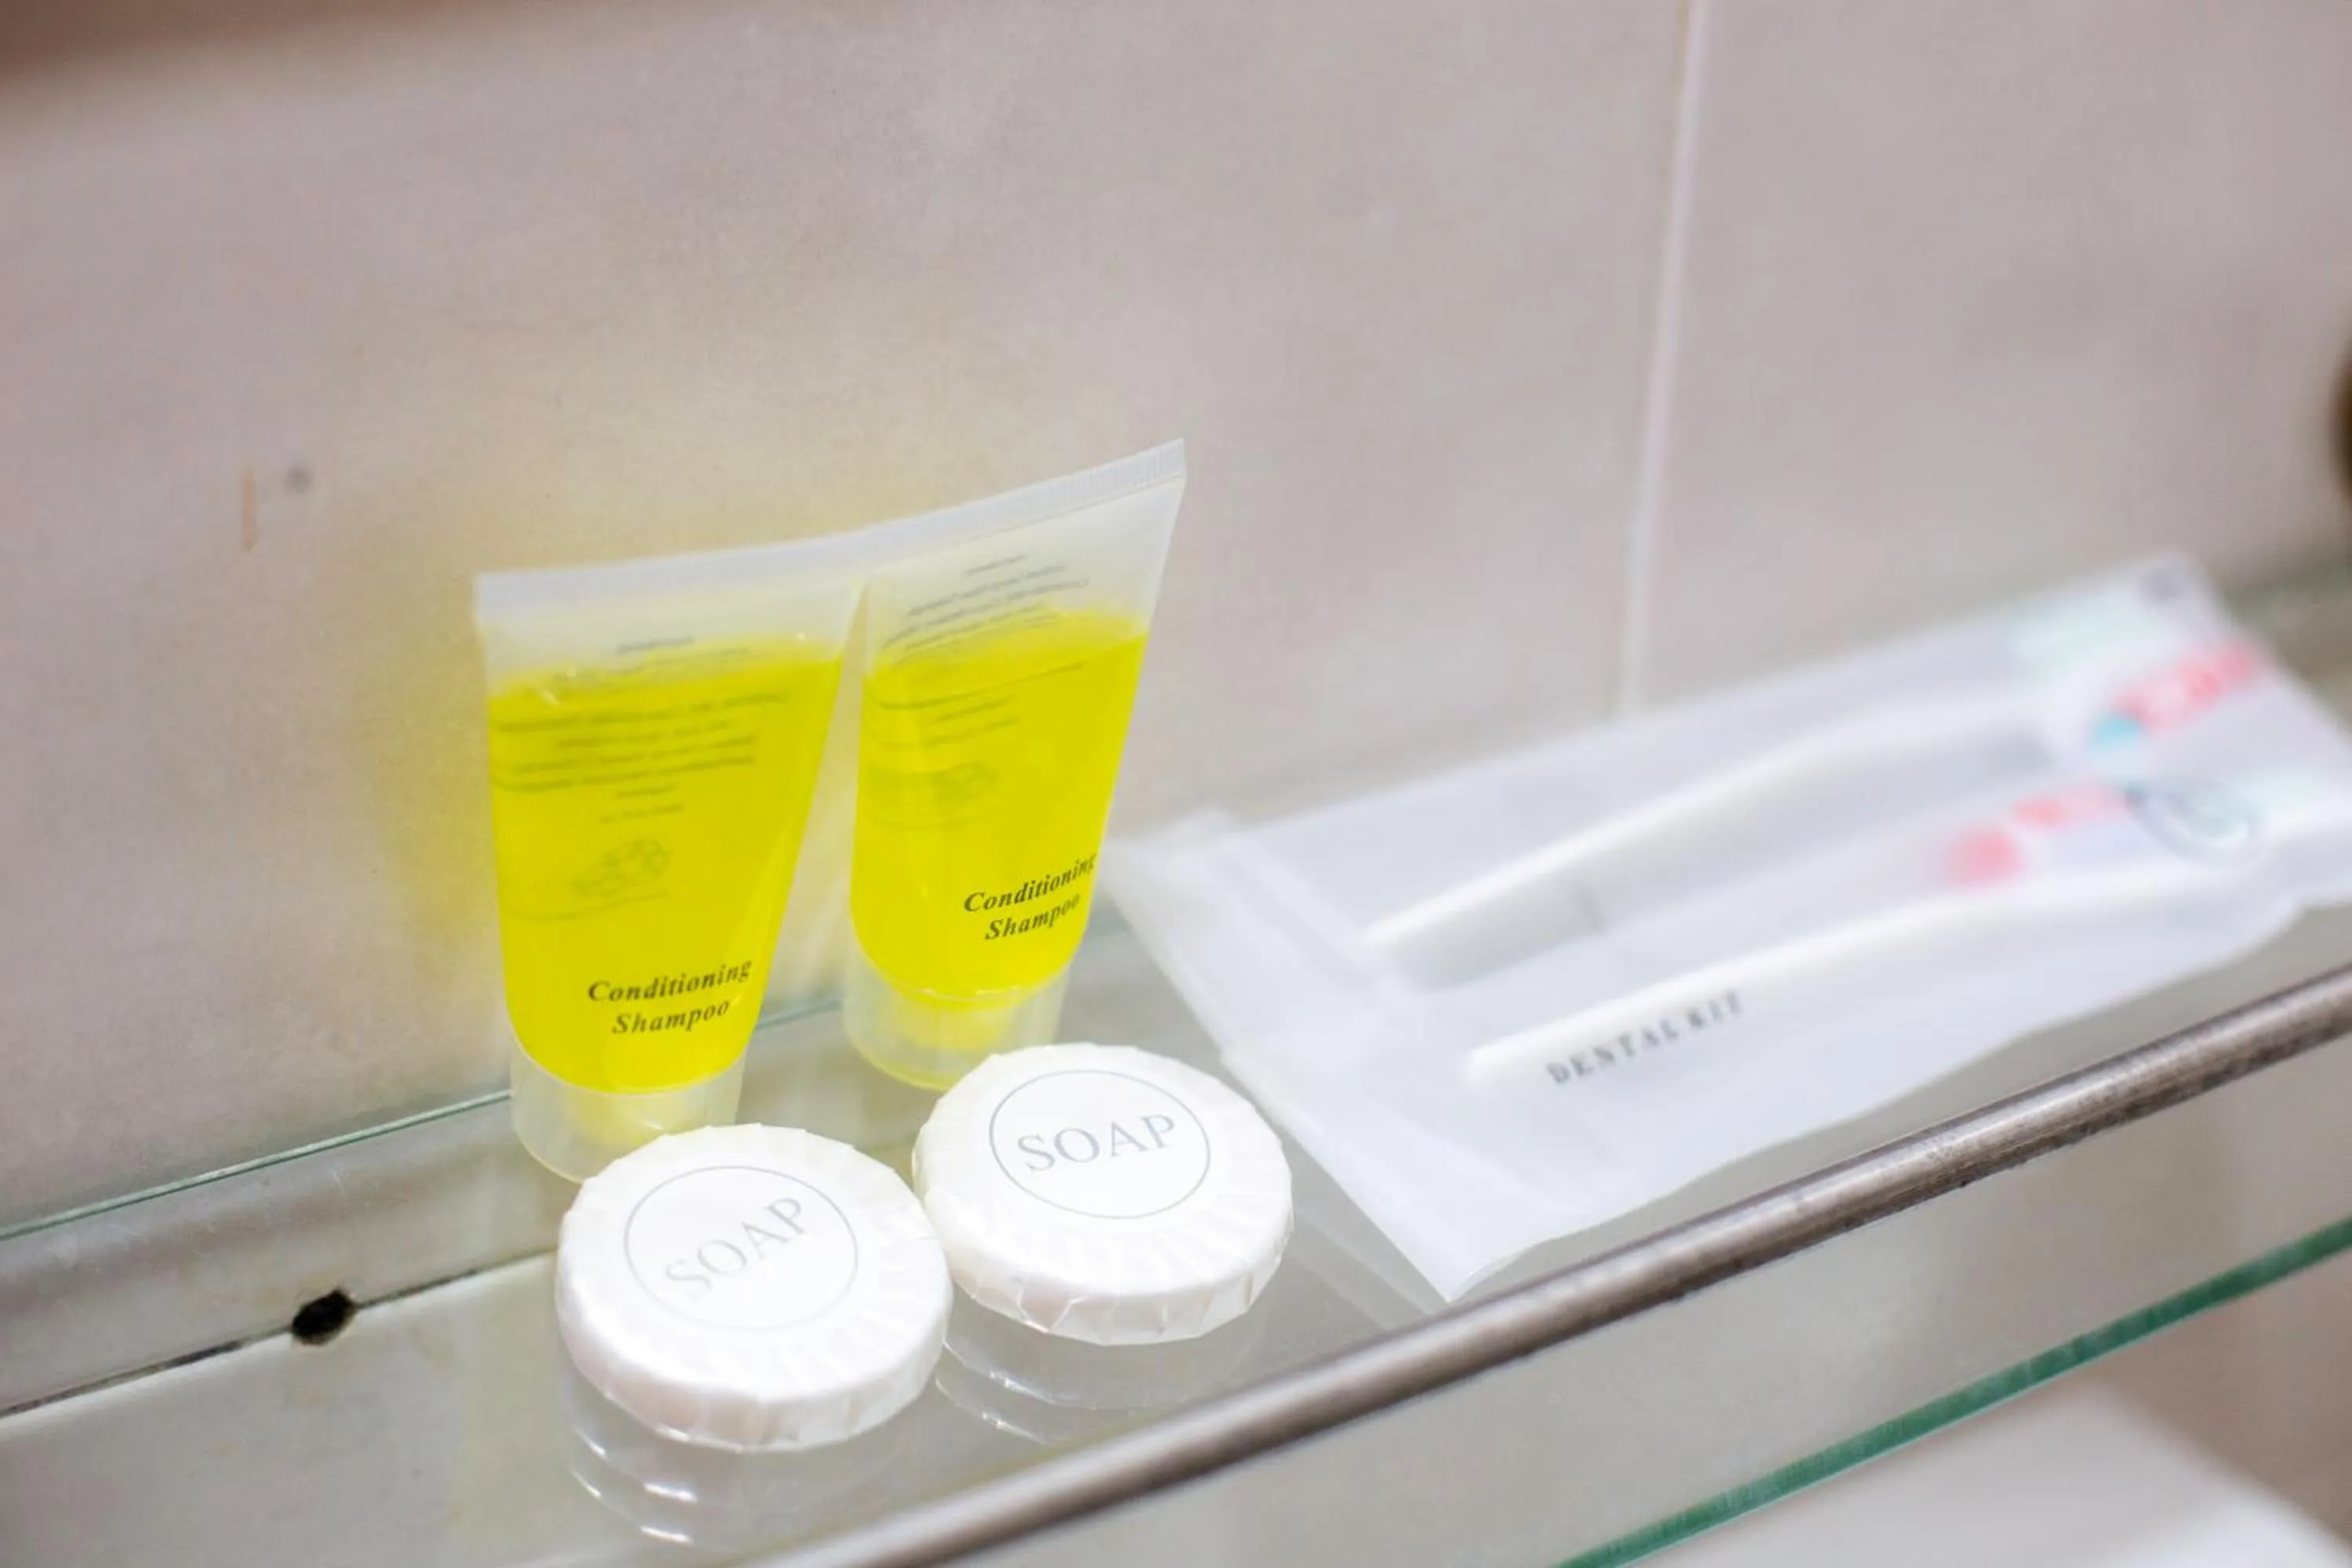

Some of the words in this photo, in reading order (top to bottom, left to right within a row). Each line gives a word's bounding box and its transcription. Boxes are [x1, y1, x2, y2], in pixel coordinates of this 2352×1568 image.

[985, 893, 1080, 941] Shampoo
[587, 960, 753, 1002] Conditioning
[612, 1000, 731, 1035] Shampoo
[1546, 1019, 1680, 1085] DENTAL
[1686, 990, 1741, 1029] KIT
[1017, 1113, 1174, 1171] SOAP
[666, 1198, 806, 1298] SOAP
